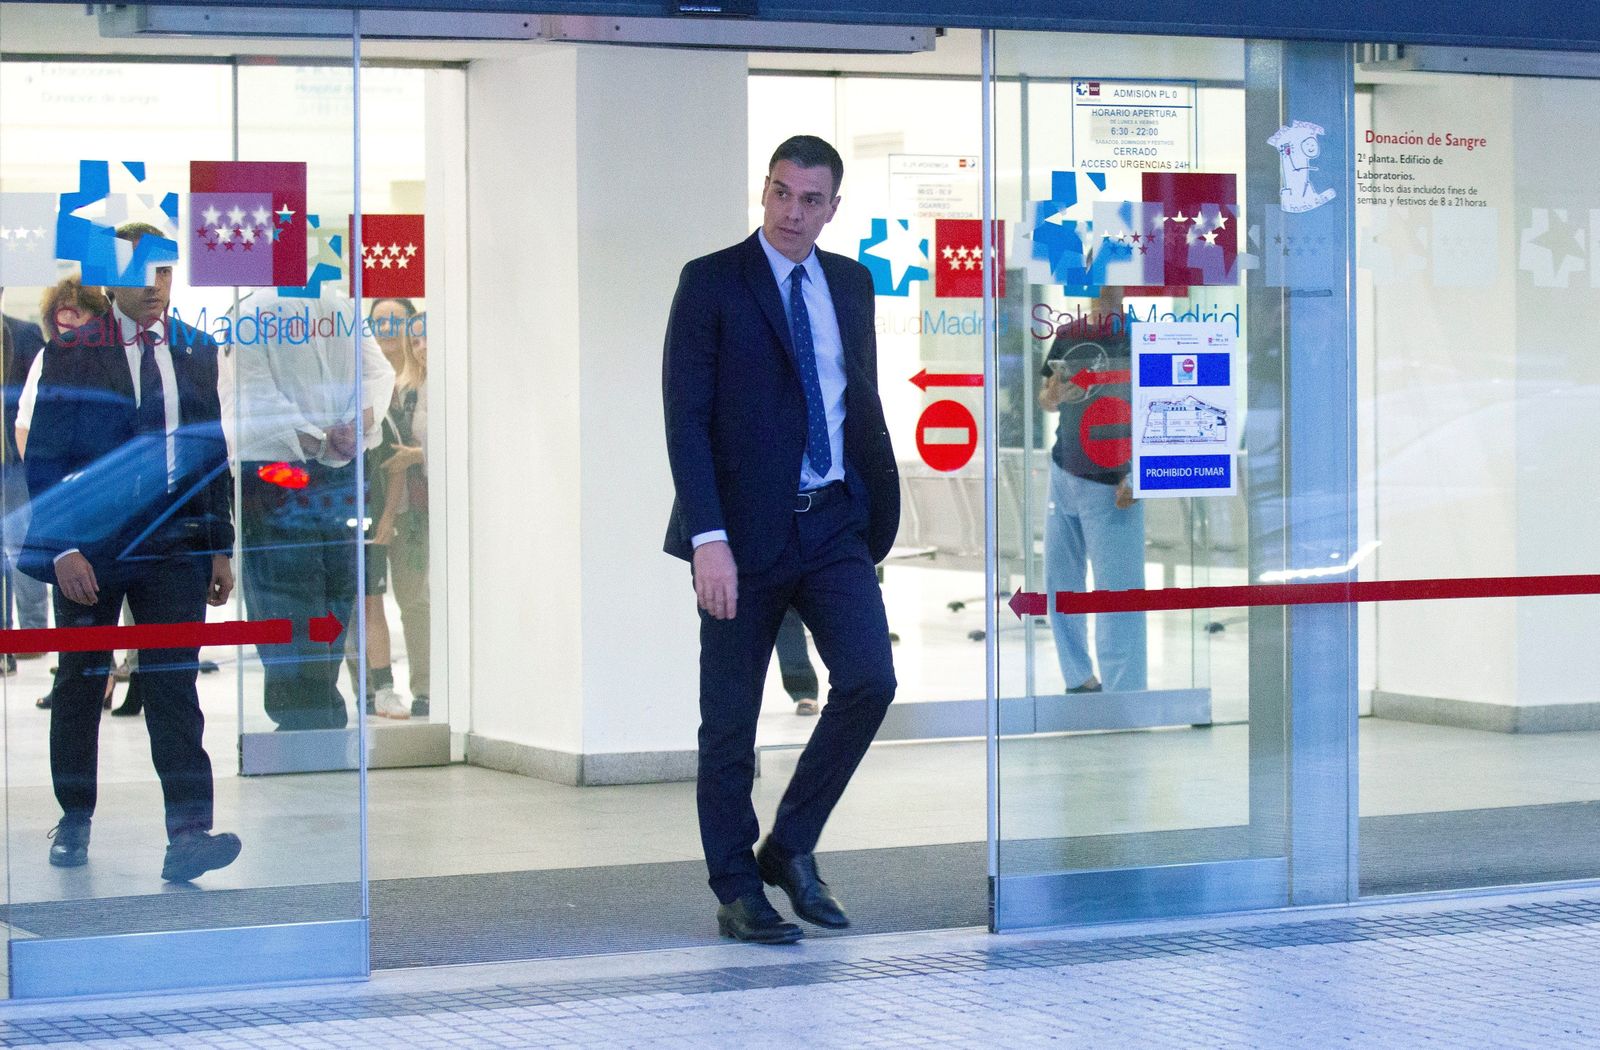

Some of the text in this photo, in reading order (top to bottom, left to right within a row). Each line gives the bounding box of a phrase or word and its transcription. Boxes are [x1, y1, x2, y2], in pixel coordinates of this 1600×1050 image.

[1091, 108, 1177, 118] HORARIO APERTURA
[1111, 127, 1129, 135] 6:30
[1136, 127, 1159, 136] 22:00
[1365, 130, 1487, 151] Donación de Sangre
[1113, 147, 1158, 156] CERRADO
[1081, 159, 1190, 169] ACCESO URGENCIAS 24H
[1368, 153, 1398, 165] planta.
[1400, 154, 1430, 165] Edificio
[1433, 155, 1443, 165] de
[1357, 170, 1415, 180] Laboratorios.
[1357, 182, 1381, 193] Todos
[1383, 184, 1394, 193] los
[1413, 184, 1445, 195] incluidos
[1447, 185, 1466, 195] fines
[1468, 186, 1478, 195] de
[1357, 197, 1387, 205] semana
[1389, 198, 1395, 207] y
[1397, 196, 1426, 206] festivos
[1428, 196, 1439, 206] de
[1440, 197, 1446, 206] 8
[1146, 467, 1224, 477] PROHIBIDO FUMAR
